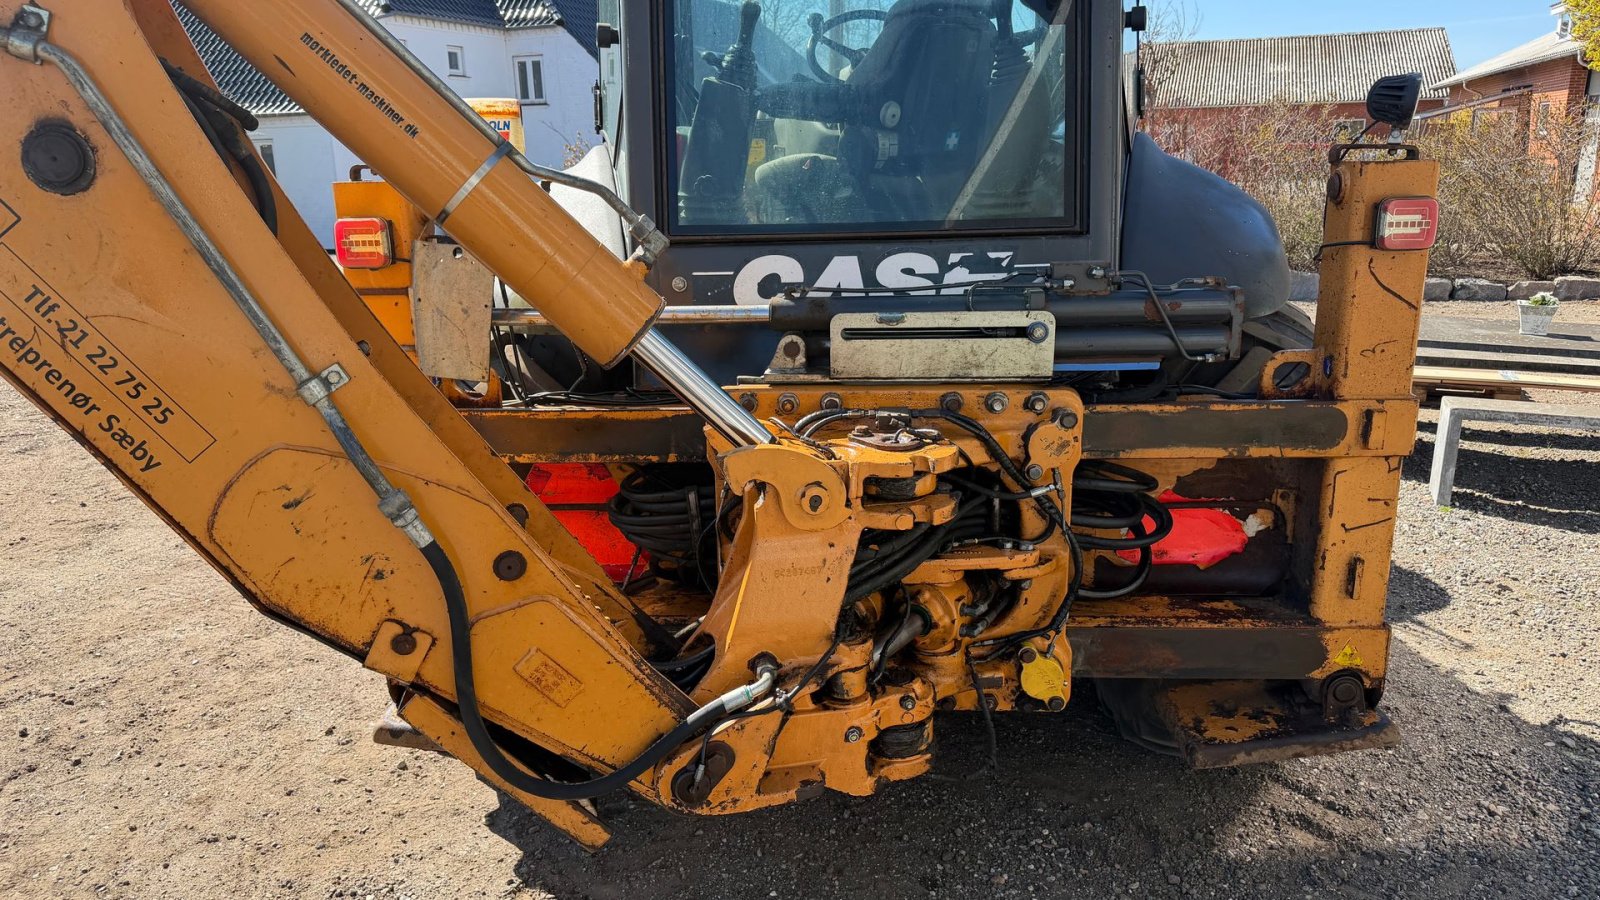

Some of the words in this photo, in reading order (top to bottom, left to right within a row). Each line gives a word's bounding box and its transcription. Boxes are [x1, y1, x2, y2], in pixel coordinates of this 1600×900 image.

[300, 31, 419, 139] mørkledet-maskiner.dk
[85, 345, 119, 376] 22
[114, 370, 147, 400] 75
[141, 396, 175, 425] 25
[99, 414, 162, 472] Sæby
